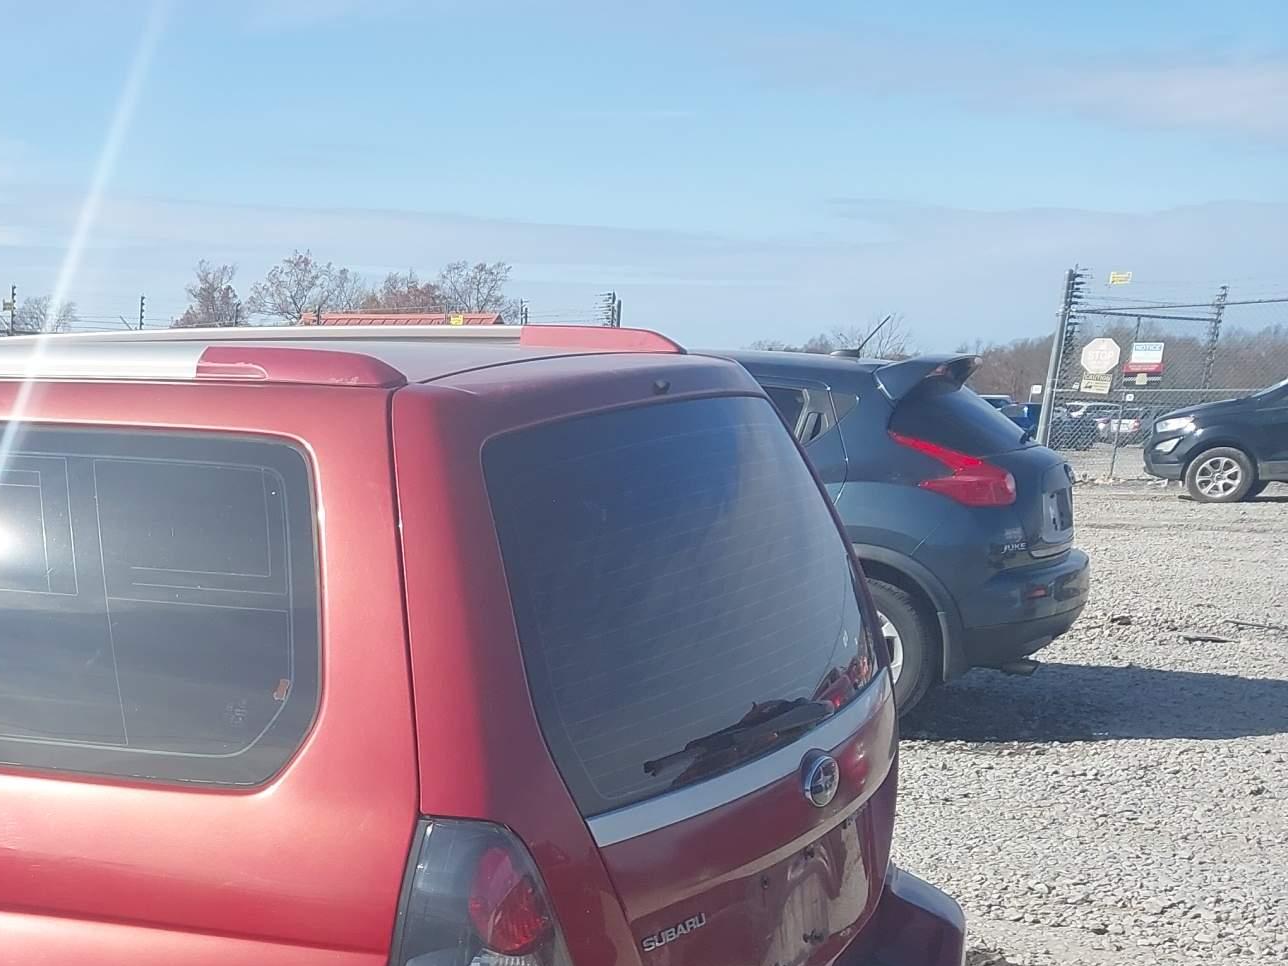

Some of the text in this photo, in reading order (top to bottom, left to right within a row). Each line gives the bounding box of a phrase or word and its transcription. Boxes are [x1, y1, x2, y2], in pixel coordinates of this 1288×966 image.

[1087, 350, 1114, 361] STOP
[1001, 542, 1027, 554] JUKE
[641, 912, 707, 952] SUBARU
